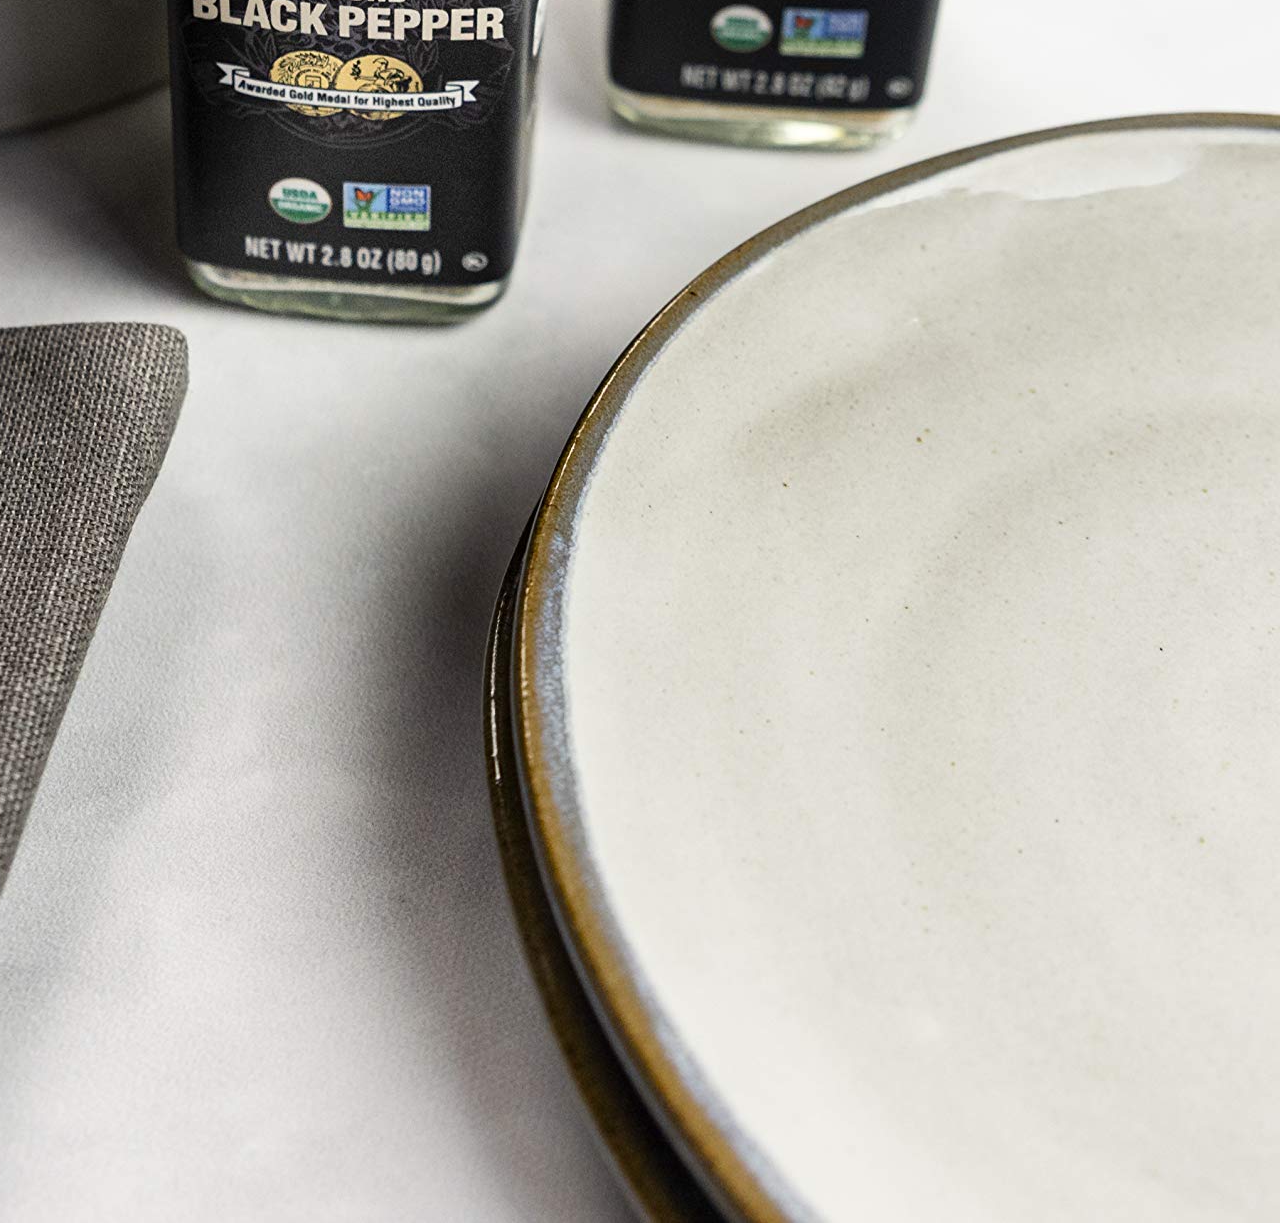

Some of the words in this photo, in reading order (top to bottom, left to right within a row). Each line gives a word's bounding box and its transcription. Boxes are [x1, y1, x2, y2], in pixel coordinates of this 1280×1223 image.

[338, 4, 506, 42] PEPPER
[238, 79, 286, 98] Awarded
[289, 89, 315, 102] Gold
[317, 92, 351, 105] Medal
[354, 95, 369, 106] for
[372, 96, 415, 108] Highest
[417, 95, 456, 107] Quality
[244, 234, 281, 261] NET
[285, 240, 318, 265] WT
[321, 243, 354, 268] 2.8
[356, 246, 384, 270] OZ
